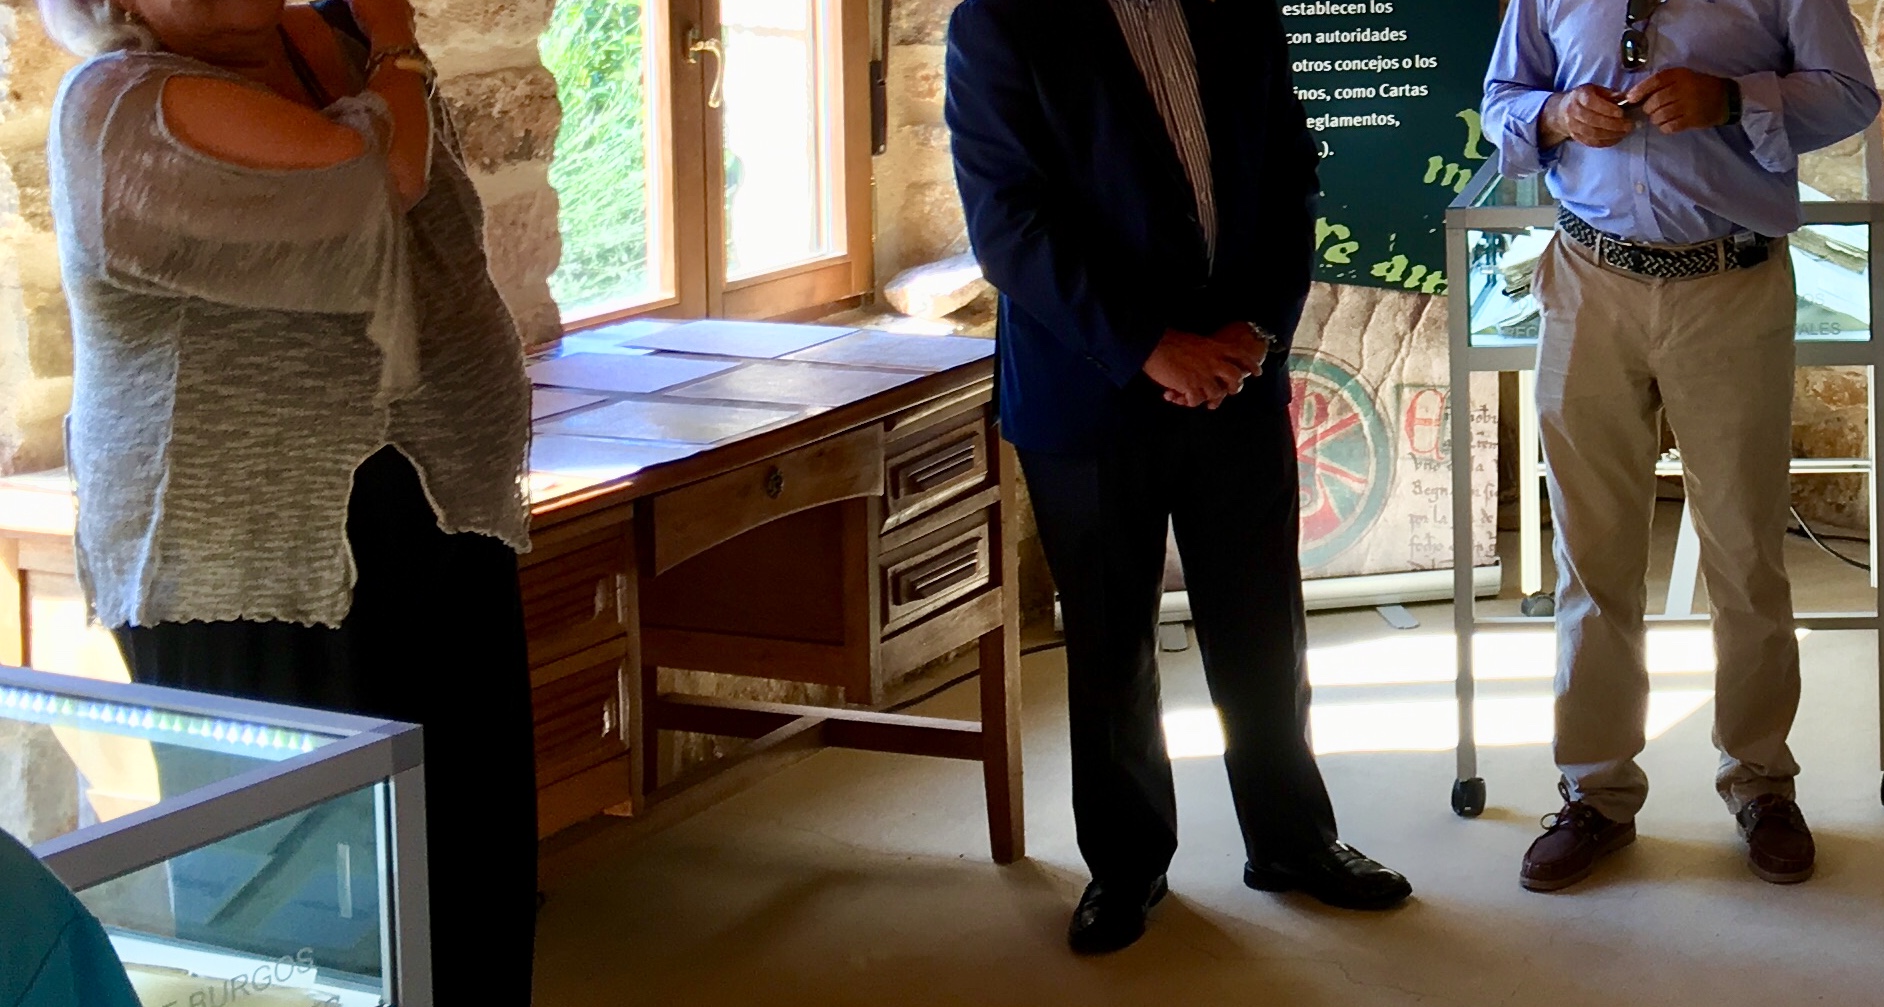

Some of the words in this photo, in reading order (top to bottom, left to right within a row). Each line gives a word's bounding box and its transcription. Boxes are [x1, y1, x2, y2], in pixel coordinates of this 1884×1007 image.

[1281, 0, 1367, 17] establecen
[1369, 0, 1394, 14] los
[1314, 26, 1408, 44] autoridades
[1291, 58, 1333, 73] otros
[1334, 55, 1400, 73] concejos
[1401, 57, 1413, 69] o
[1414, 54, 1438, 69] los
[1333, 86, 1377, 100] como
[1378, 83, 1429, 98] Cartas
[1305, 112, 1401, 132] eglamentos,
